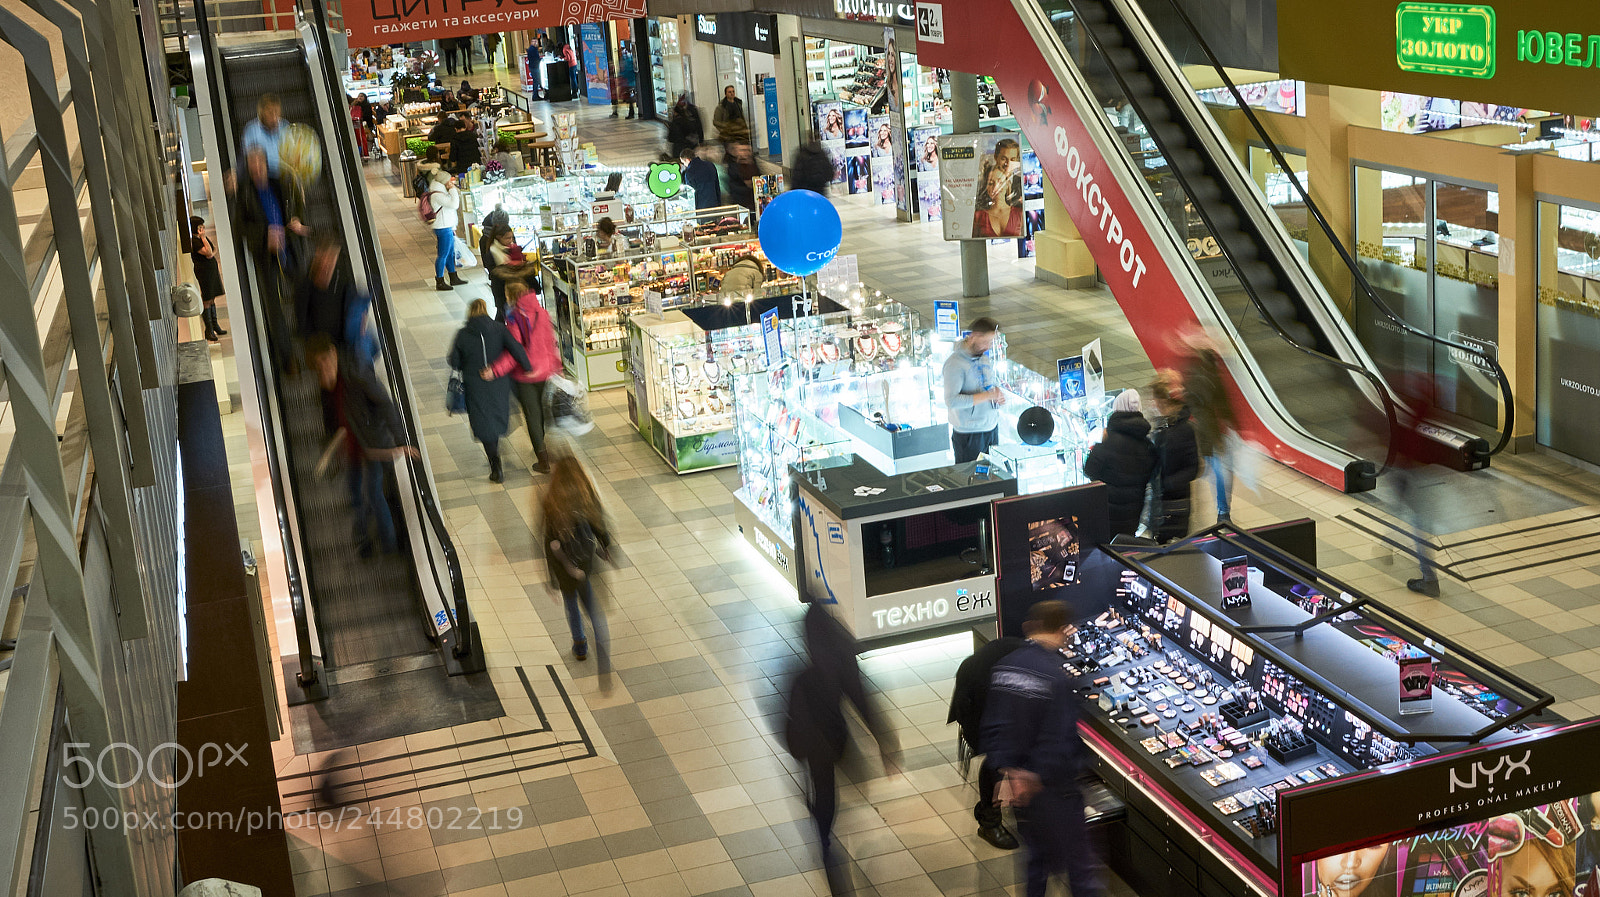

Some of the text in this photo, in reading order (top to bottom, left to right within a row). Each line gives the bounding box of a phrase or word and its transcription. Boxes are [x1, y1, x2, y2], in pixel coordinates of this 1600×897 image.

[373, 8, 540, 35] гаджети та аксесуари
[1422, 16, 1463, 34] УКР
[1402, 39, 1485, 62] ЗОЛОТО
[1517, 30, 1600, 69] ЮВЕЛ
[1054, 126, 1147, 289] ФОКСТРОТ
[872, 588, 992, 629] техно ёж
[1226, 594, 1248, 605] NYX
[1449, 749, 1532, 794] NYX
[1515, 780, 1562, 797] MAKEUP
[1425, 881, 1452, 890] ULTIMATE
